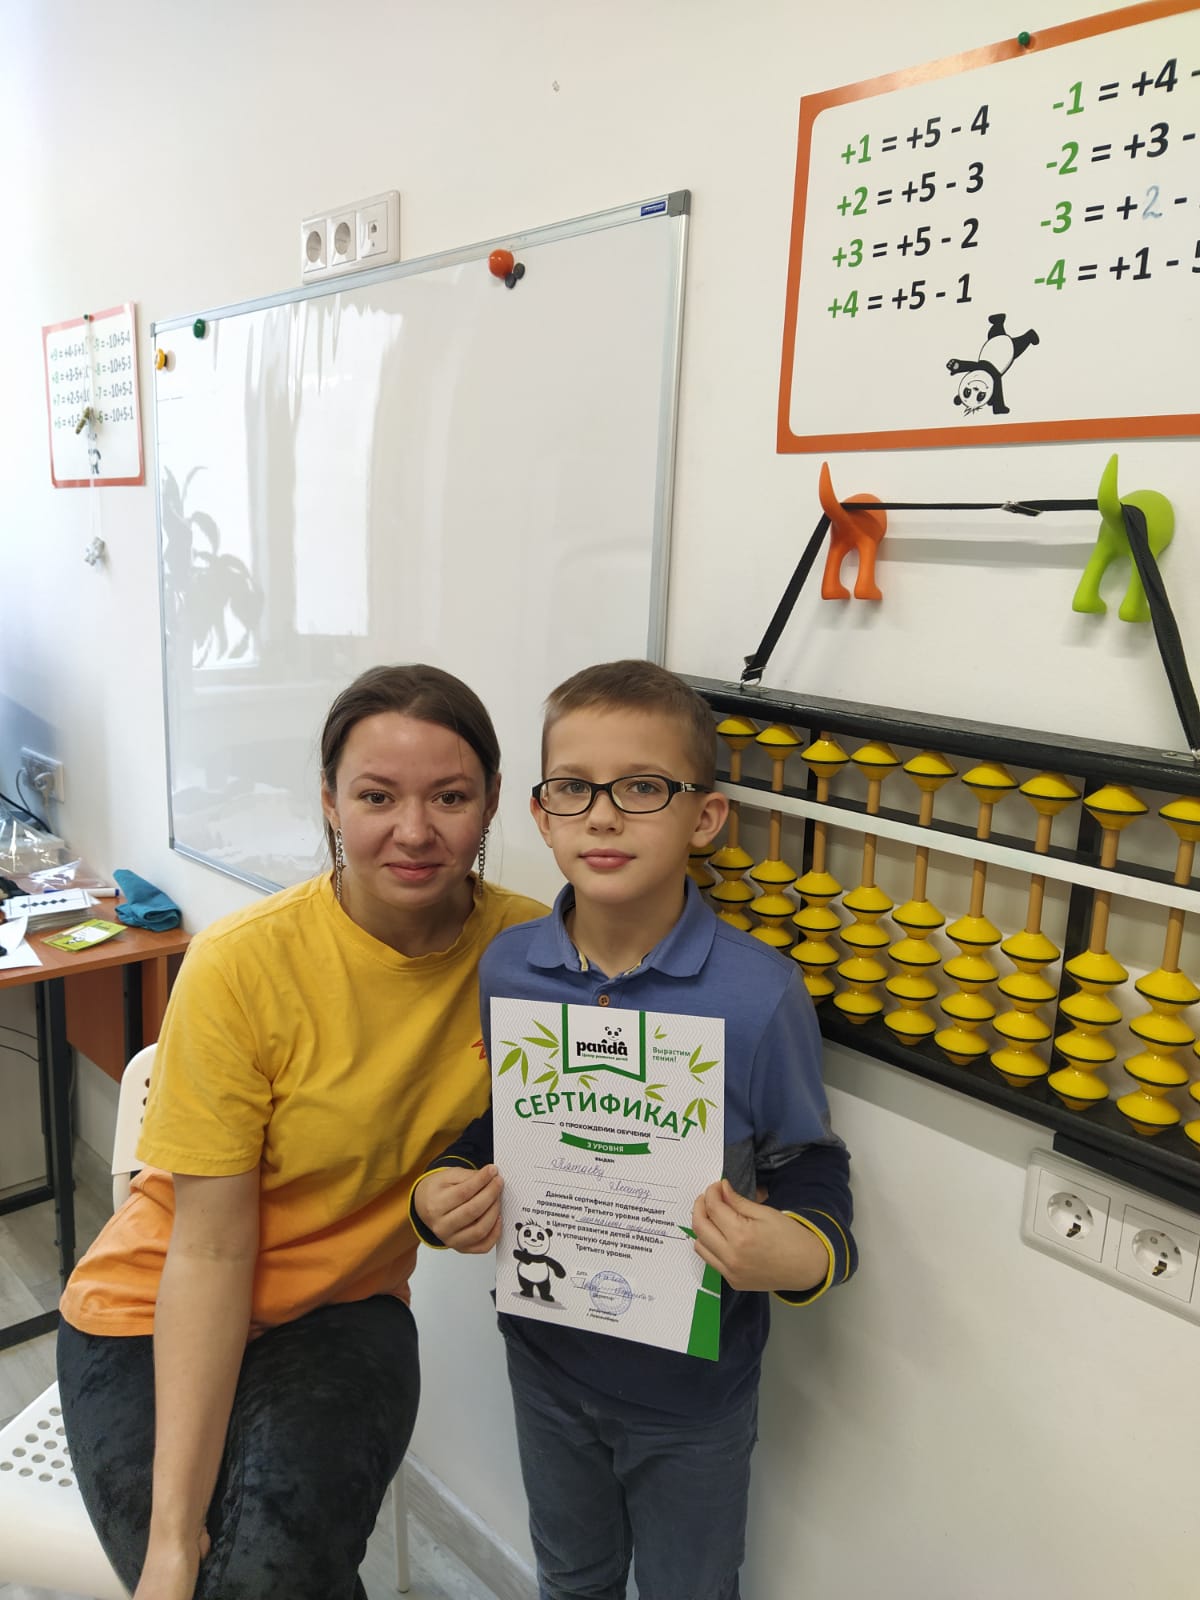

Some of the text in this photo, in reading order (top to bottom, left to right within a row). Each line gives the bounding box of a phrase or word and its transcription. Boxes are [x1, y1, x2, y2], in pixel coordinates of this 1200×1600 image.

[1052, 81, 1085, 116] -1
[1098, 81, 1119, 103] =
[1131, 58, 1177, 97] +4
[841, 105, 990, 165] +1 = +5 - 4
[1045, 122, 1196, 176] -2 = +3 -
[836, 161, 985, 217] +2 = +5 - 3
[1040, 201, 1073, 235] -3
[1083, 203, 1105, 224] =
[1174, 196, 1188, 205] -
[831, 217, 979, 270] +3 = +5 - 2
[1033, 258, 1067, 291] -4
[1077, 263, 1098, 282] =
[1108, 246, 1152, 283] +1
[1166, 259, 1180, 267] -
[827, 273, 973, 319] +4 = +5 - 1
[576, 1038, 628, 1056] panda
[652, 1046, 691, 1057] Вырастим
[514, 1090, 698, 1139] СЕРТИФИКАТ
[565, 1122, 616, 1134] ПРОХОЖДЕНИИ
[616, 1128, 651, 1138] ОБУЧЕНИЯ
[593, 1142, 624, 1153] УРОВНЯ
[531, 1208, 570, 1219] программе
[545, 1190, 666, 1216] Данный сертификат подтверждает
[552, 1220, 576, 1230] Центре
[577, 1225, 609, 1235] развития
[609, 1231, 631, 1239] детей
[584, 1206, 614, 1217] Третьего
[641, 1216, 675, 1227] обучения
[562, 1232, 598, 1244] успешную
[598, 1239, 619, 1248] сдачу
[620, 1242, 653, 1253] экзамена
[575, 1243, 605, 1255] Третьего
